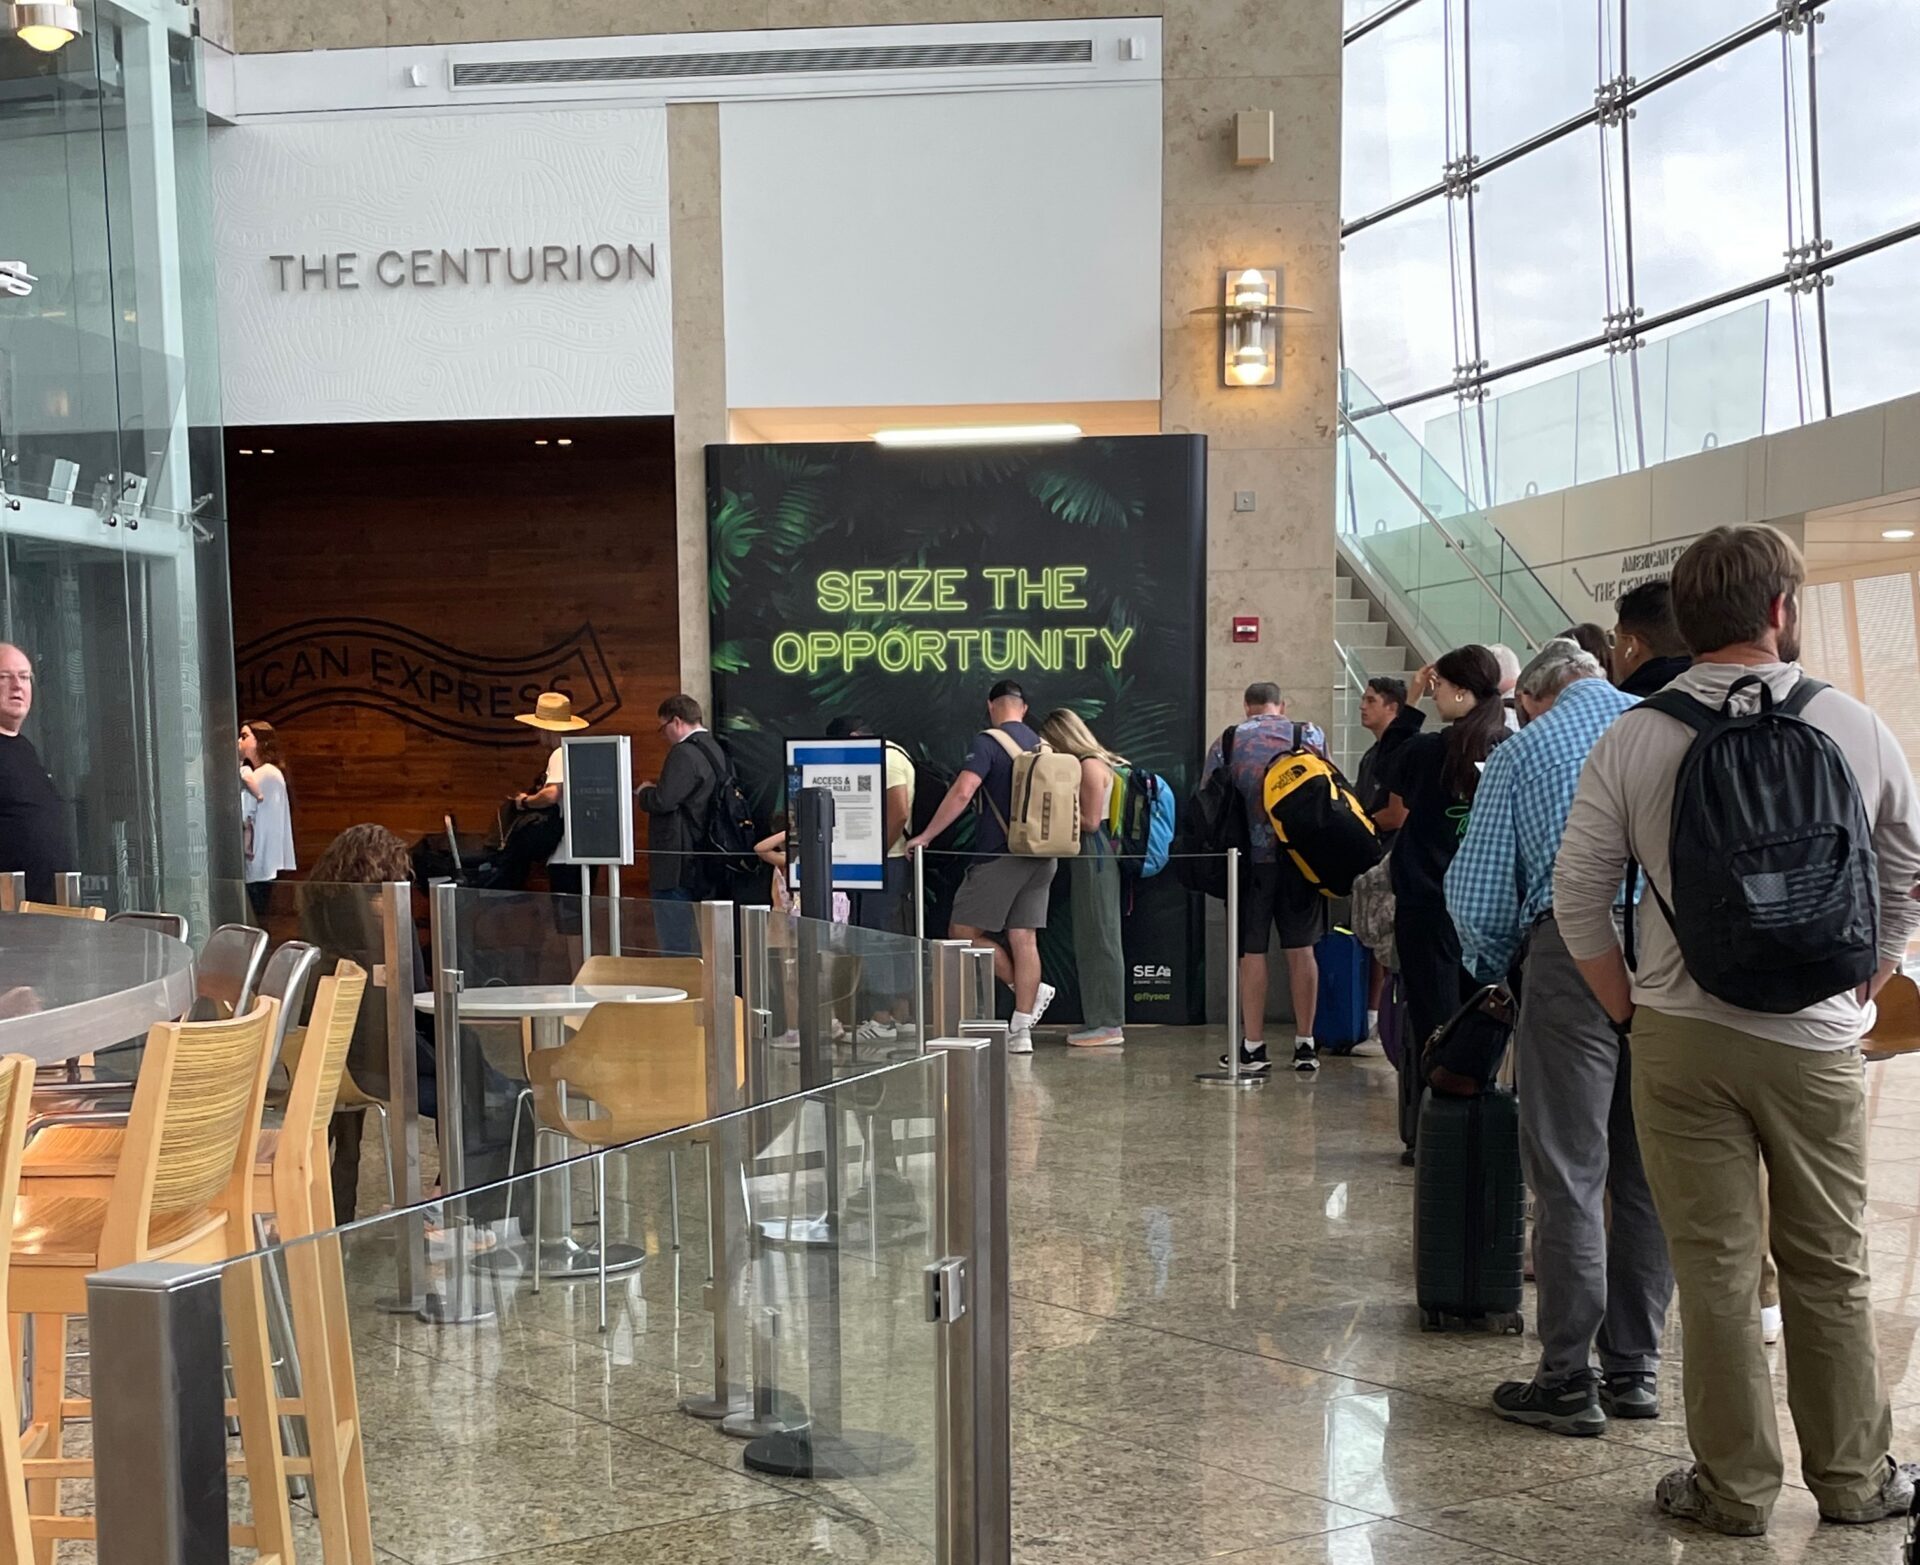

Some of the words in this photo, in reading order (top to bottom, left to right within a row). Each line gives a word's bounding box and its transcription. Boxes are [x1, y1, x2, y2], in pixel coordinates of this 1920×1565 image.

[269, 252, 360, 291] THE
[376, 243, 657, 288] CENTURION
[1622, 549, 1668, 572] AMERICAN
[816, 568, 968, 612] SEIZE
[982, 566, 1088, 610] THE
[1594, 581, 1616, 602] THE
[772, 627, 1134, 673] OPPORTUNITY
[239, 645, 349, 708] ICAN
[812, 776, 843, 785] ACCESS
[844, 776, 850, 785] &
[1133, 965, 1171, 977] SEA
